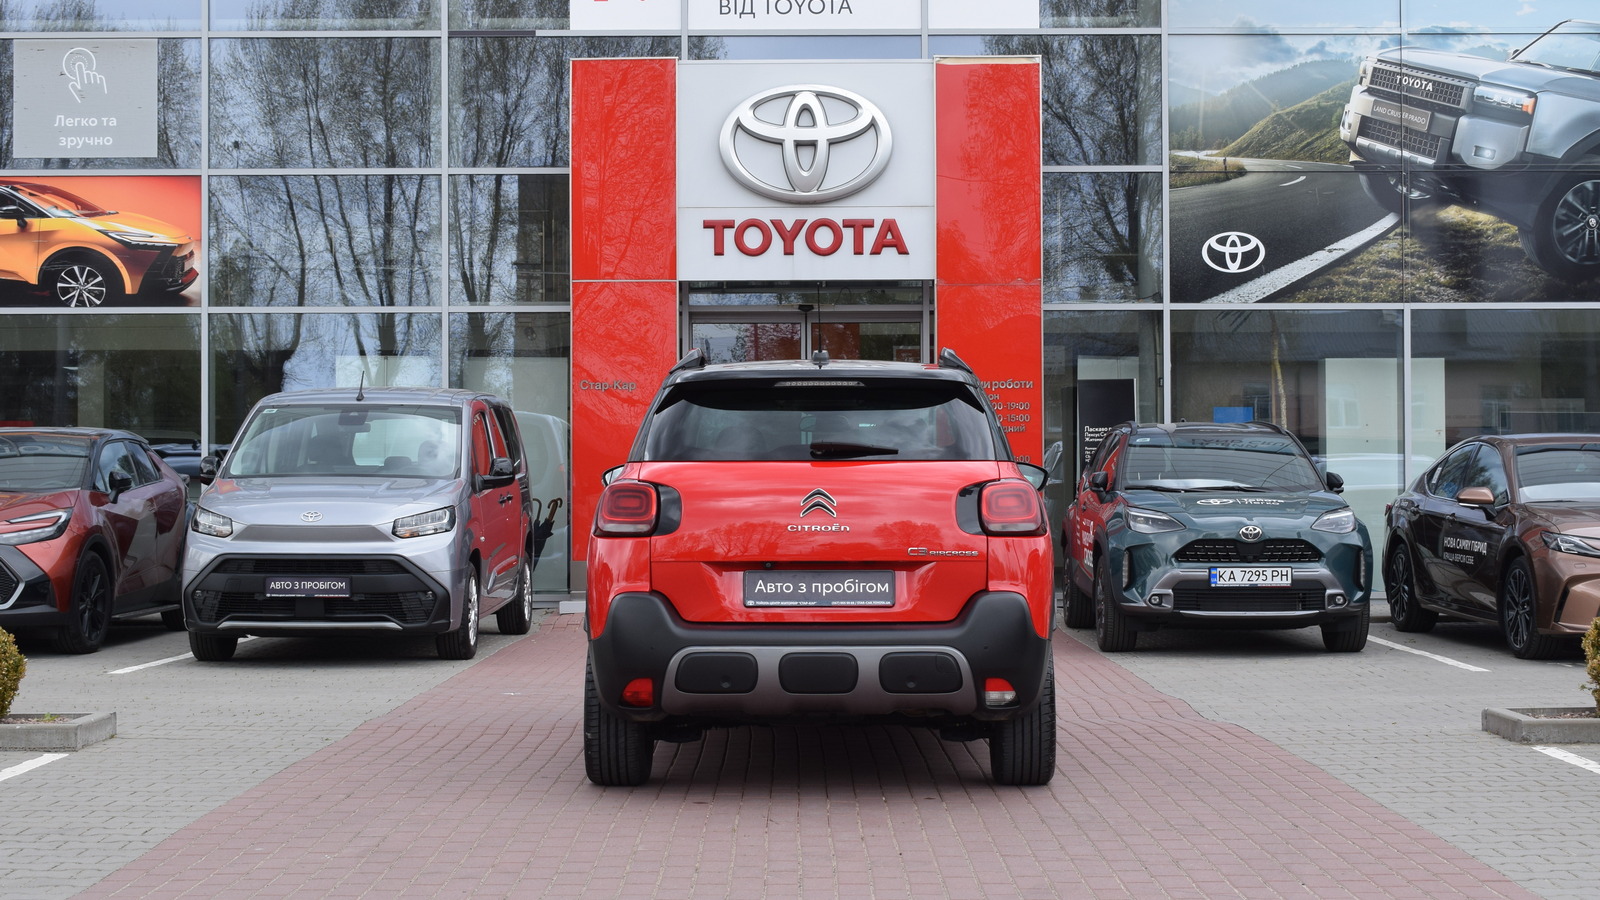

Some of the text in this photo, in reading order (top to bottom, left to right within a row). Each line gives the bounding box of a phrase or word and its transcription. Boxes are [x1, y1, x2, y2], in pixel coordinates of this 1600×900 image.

[719, 0, 756, 18] ВІД
[1396, 75, 1433, 91] TOYOTA
[54, 115, 117, 127] Легко та
[59, 136, 113, 149] зручно
[703, 218, 910, 256] TOYOTA
[580, 380, 636, 392] Стар-Кар
[992, 379, 1034, 391] роботи
[787, 524, 850, 532] CITROËN
[908, 547, 928, 556] C3
[1218, 570, 1236, 582] KA
[1240, 570, 1268, 582] 7295
[1271, 570, 1289, 581] PH
[269, 581, 346, 589] АВТО З ПРОБІГОМ
[755, 578, 889, 596] Авто з пробігом
